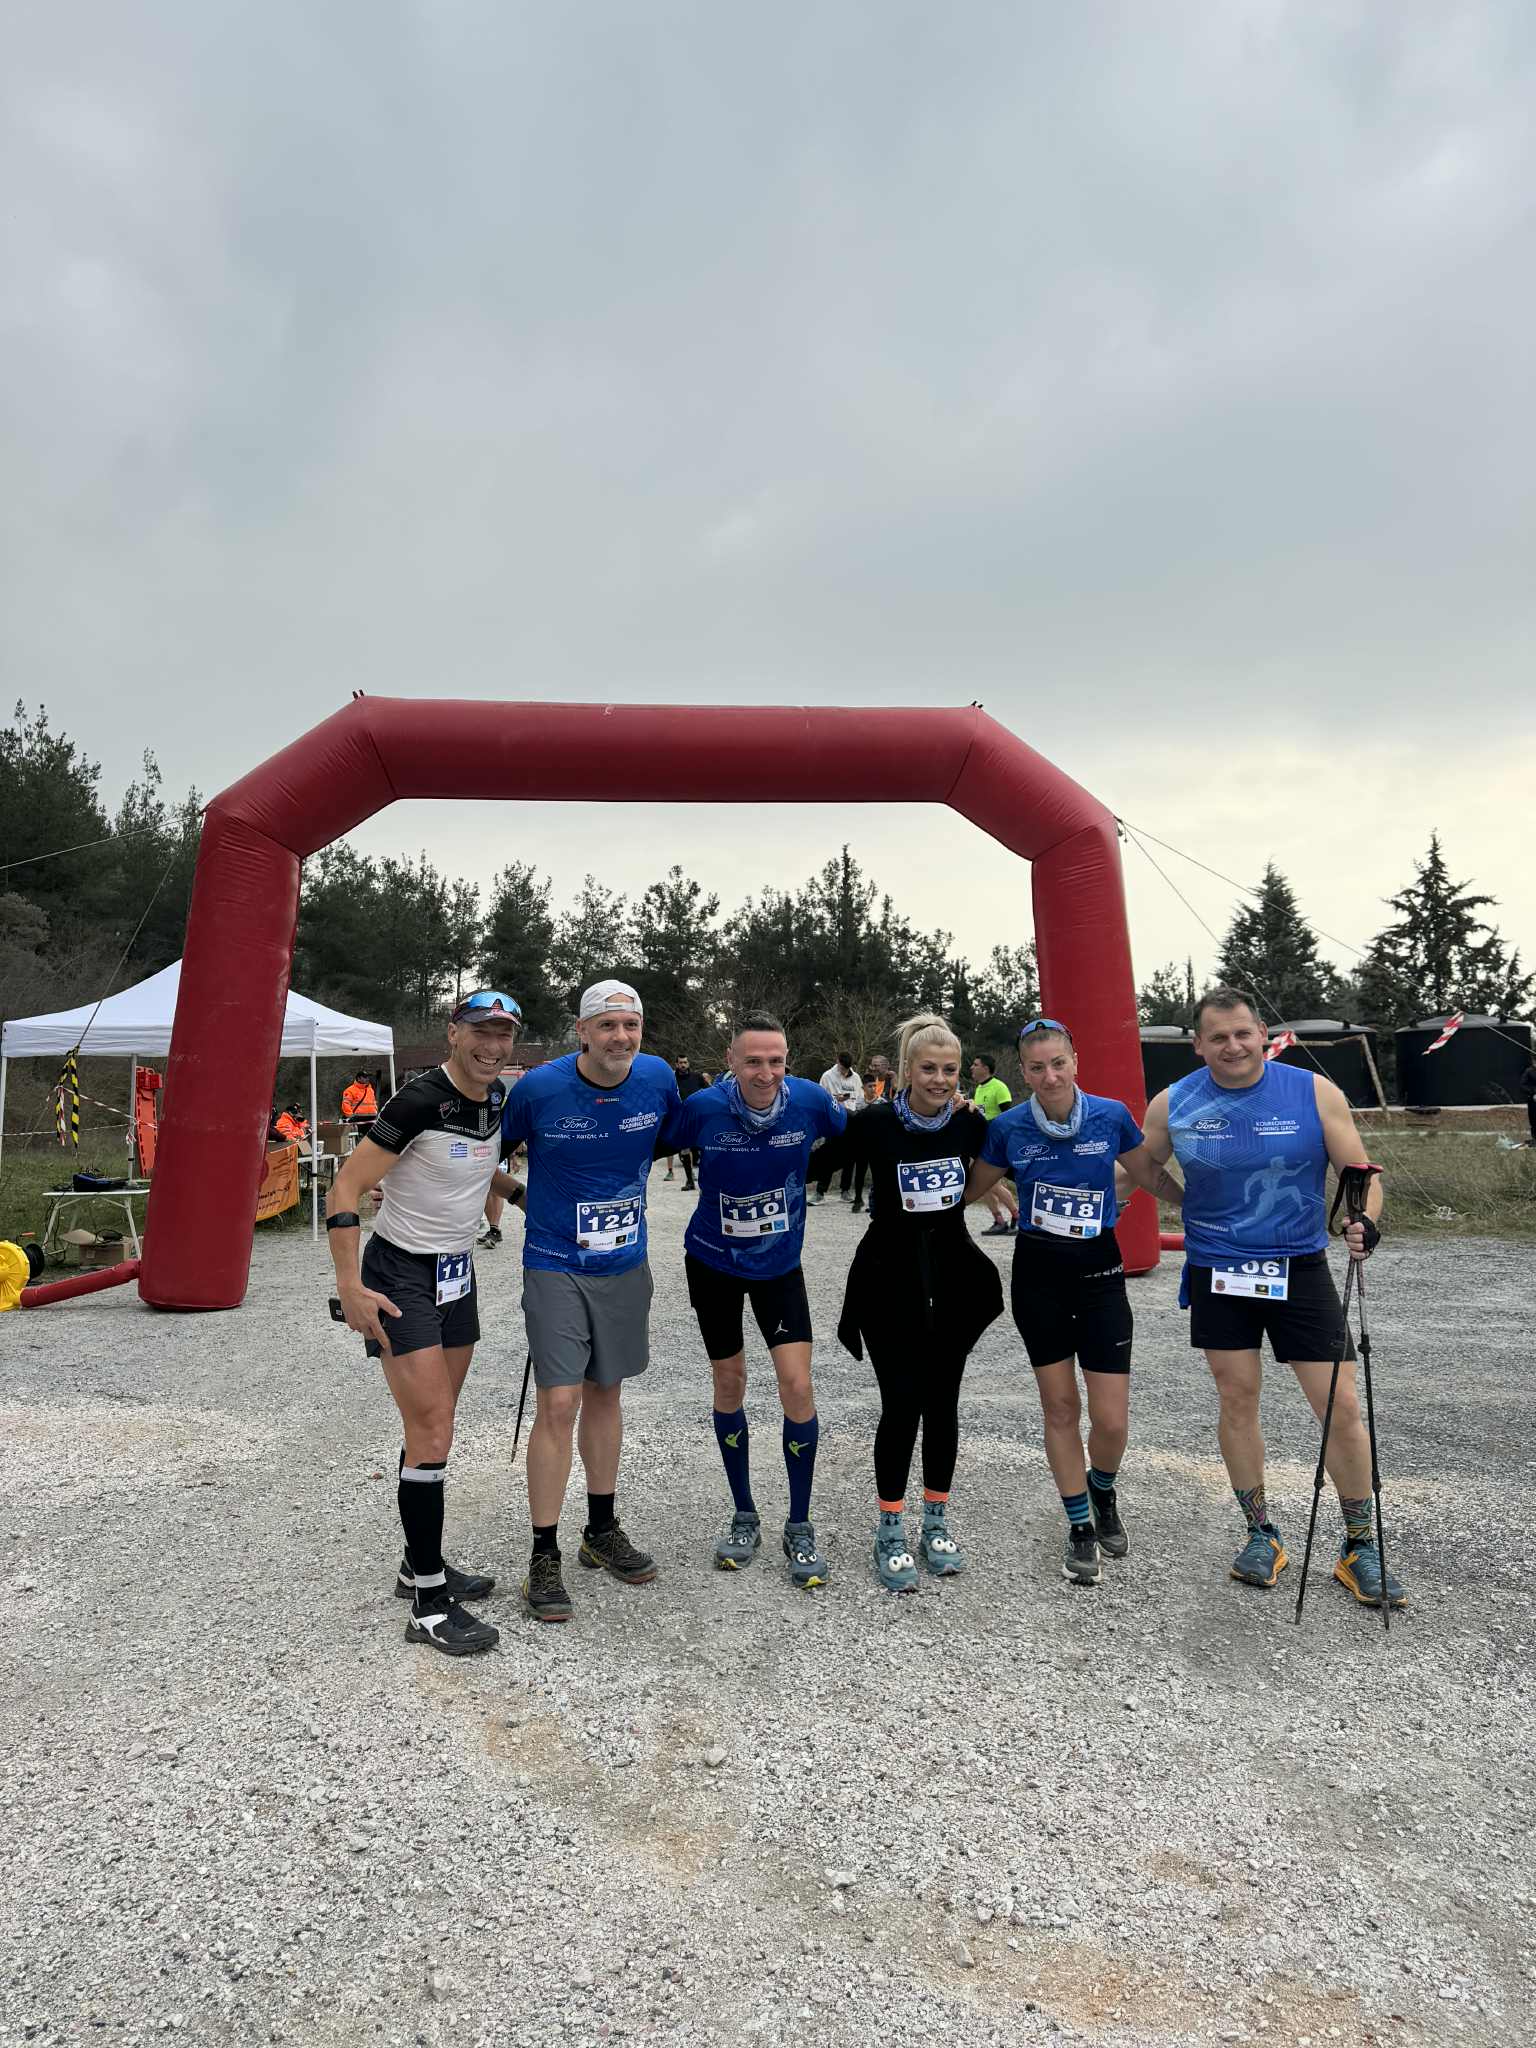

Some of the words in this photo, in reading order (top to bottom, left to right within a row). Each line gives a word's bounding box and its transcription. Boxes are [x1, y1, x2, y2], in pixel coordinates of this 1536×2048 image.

[562, 1118, 589, 1129] Ford
[1195, 1119, 1222, 1130] Ford
[720, 1133, 743, 1143] Ford
[1024, 1145, 1043, 1155] Ford
[909, 1171, 959, 1191] 132
[729, 1202, 780, 1220] 110
[1043, 1198, 1094, 1218] 118
[588, 1211, 635, 1231] 124
[1228, 1260, 1280, 1276] 06
